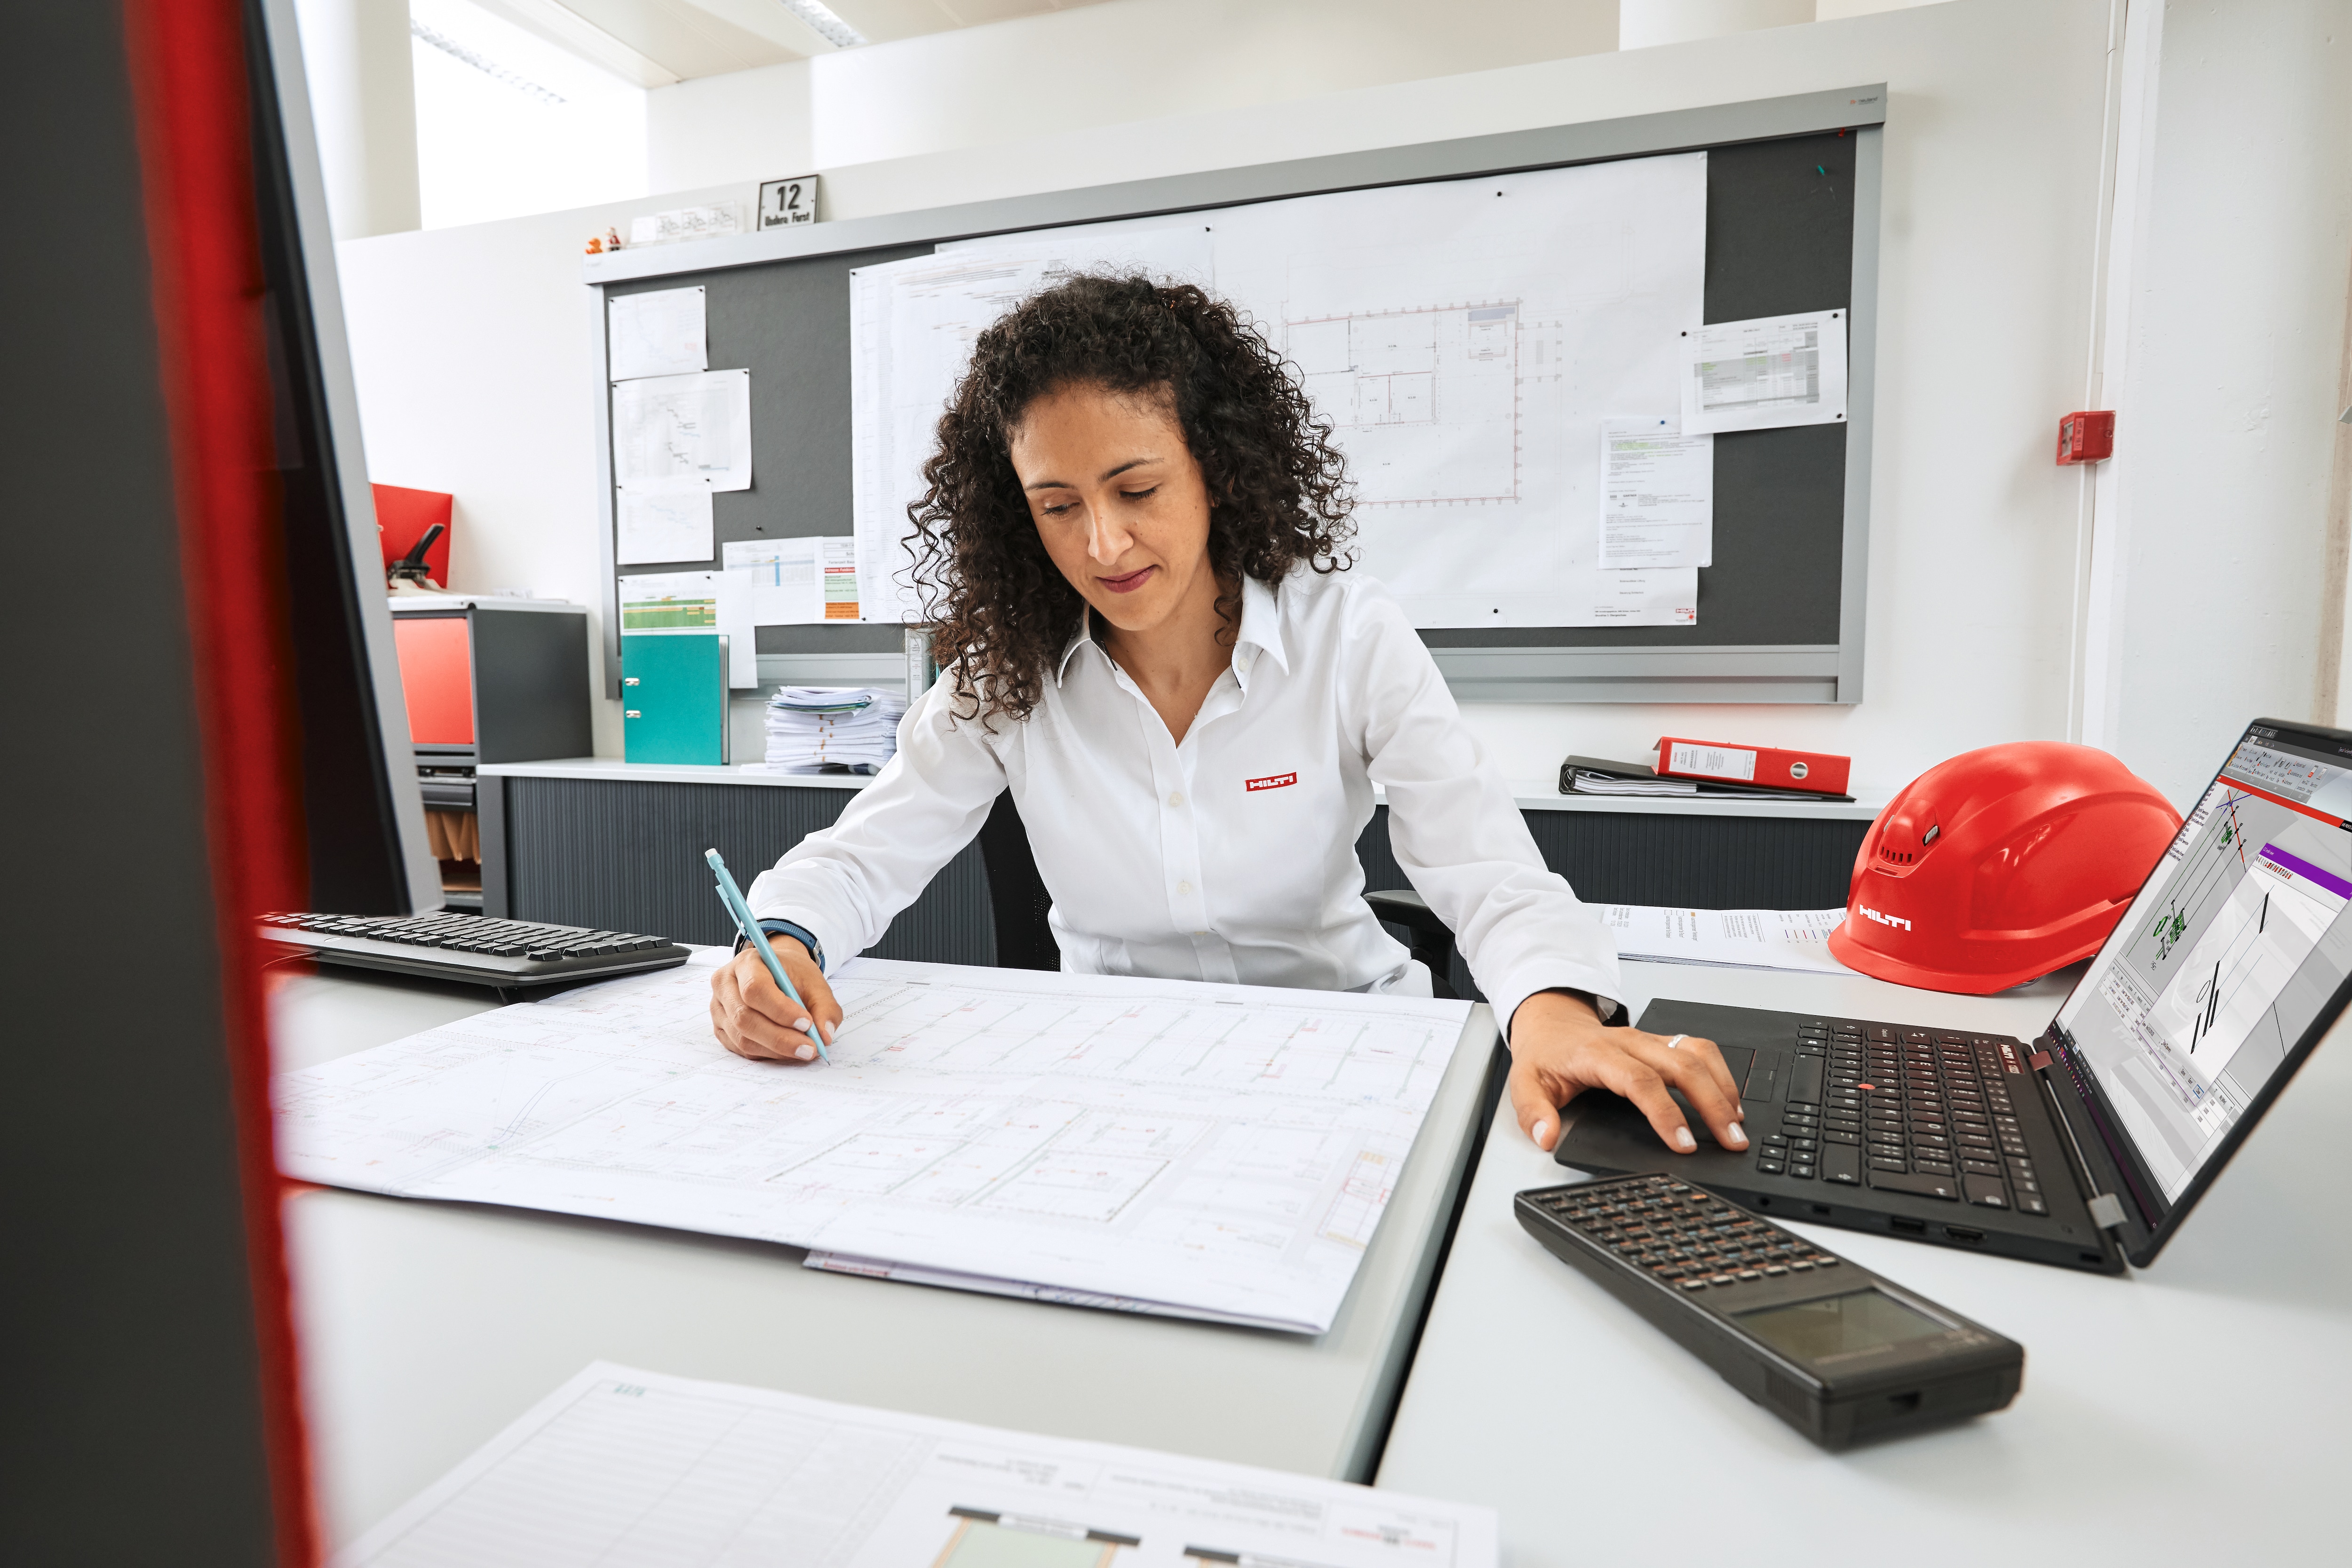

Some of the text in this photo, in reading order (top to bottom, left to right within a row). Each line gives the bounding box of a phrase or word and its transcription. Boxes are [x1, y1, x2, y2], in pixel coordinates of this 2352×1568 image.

[778, 184, 801, 211] 12
[1249, 775, 1294, 789] HILTI
[1859, 904, 1911, 931] HILTI
[2000, 1044, 2015, 1059] HILTI
